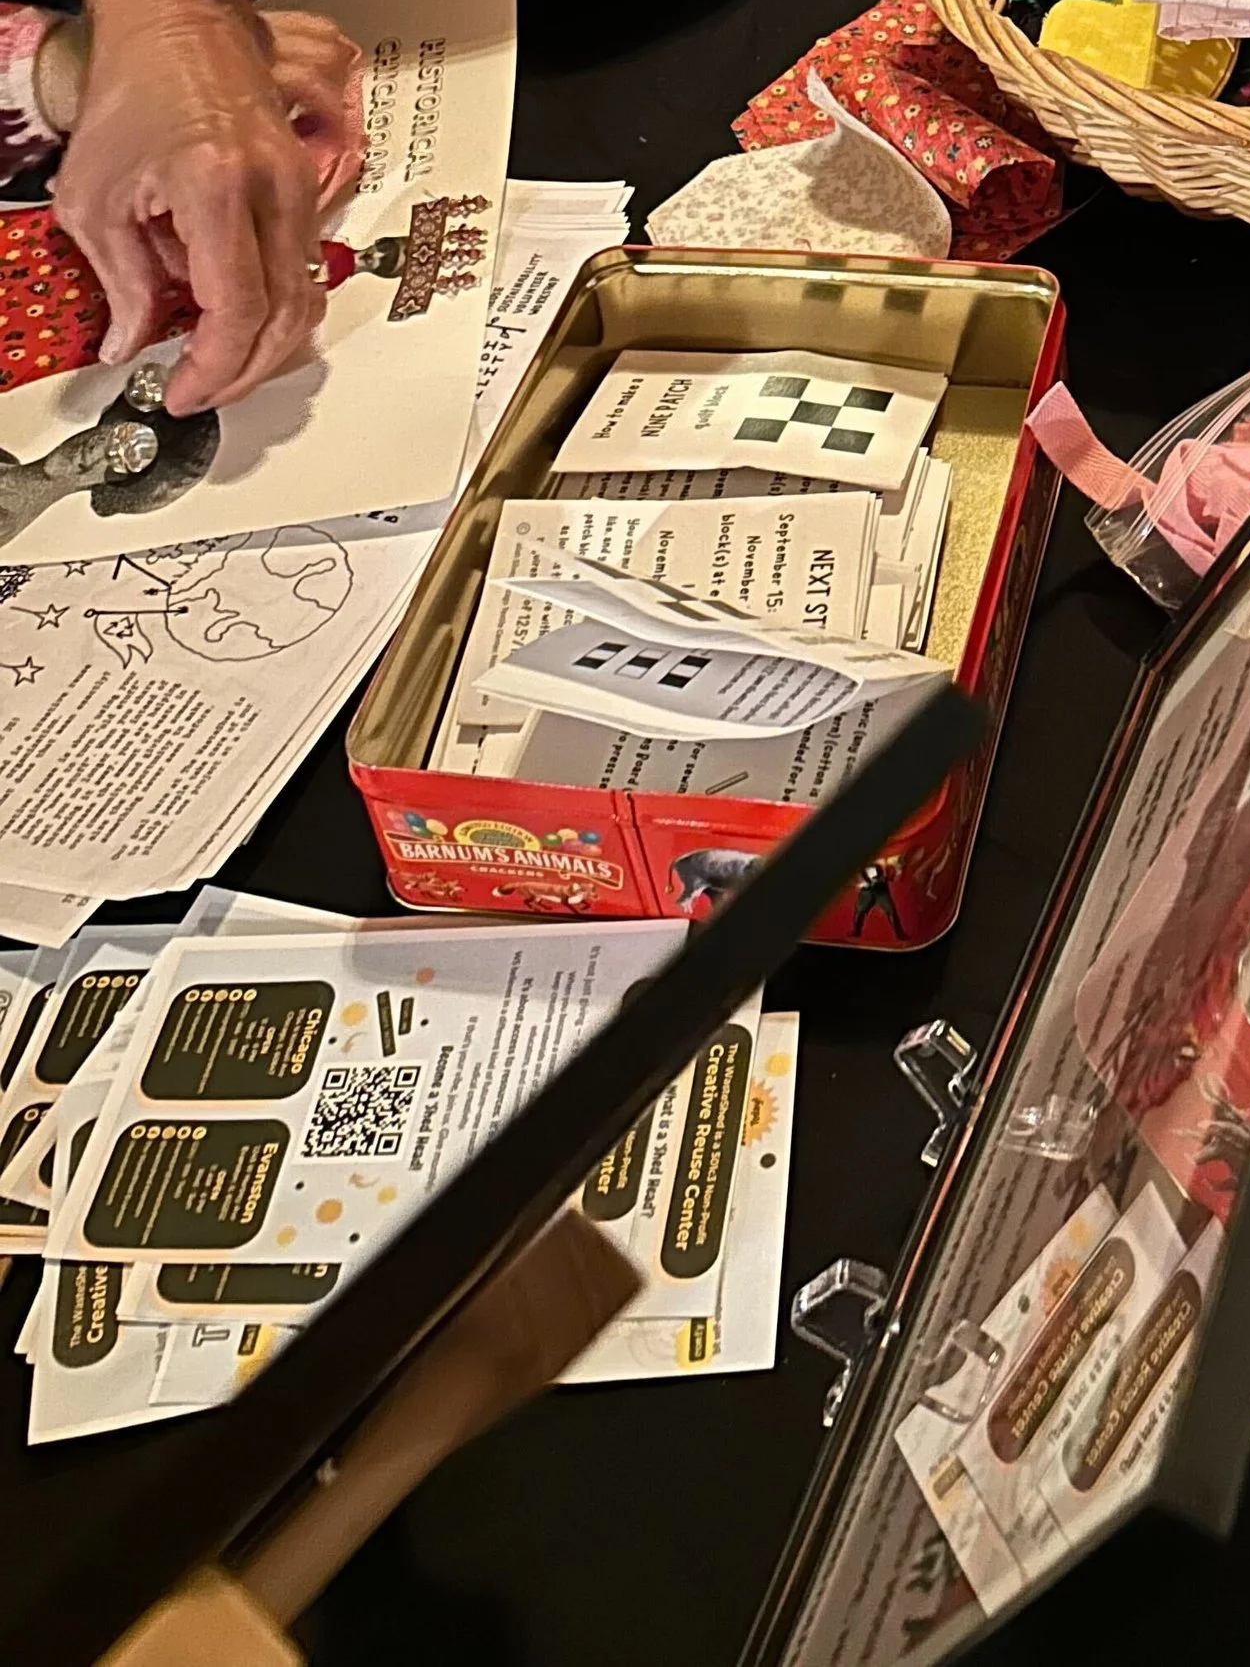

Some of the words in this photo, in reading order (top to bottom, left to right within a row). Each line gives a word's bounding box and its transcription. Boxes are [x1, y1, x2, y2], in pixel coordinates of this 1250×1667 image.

[357, 37, 401, 195] CHICAGOANS
[404, 37, 446, 183] HISTORICAL
[498, 253, 544, 313] SUSTAINABILITY
[512, 270, 548, 315] VOLUNTEER
[529, 277, 560, 316] WORKSHOP
[604, 407, 626, 418] to
[612, 384, 641, 405] make
[652, 378, 696, 410] PATCH
[702, 385, 731, 406] block
[591, 420, 620, 438] How
[636, 413, 674, 436] NINE
[687, 408, 721, 429] quilt
[580, 514, 594, 539] patch
[600, 537, 612, 553] and
[622, 538, 632, 555] can
[625, 518, 639, 536] You
[711, 514, 735, 567] block(s)
[768, 513, 795, 585] September
[711, 571, 726, 584] at
[737, 535, 762, 602] November
[806, 549, 836, 596] NEXT
[764, 590, 784, 612] 15:
[29, 691, 69, 733] creative
[68, 663, 92, 688] reuse
[34, 738, 55, 758] that
[74, 670, 113, 711] exactly?
[32, 766, 59, 794] reuse
[69, 722, 95, 748] about
[92, 693, 121, 720] using
[117, 670, 140, 691] your
[689, 741, 706, 760] for
[20, 817, 44, 840] into
[93, 727, 118, 750] When
[115, 708, 135, 725] you
[131, 679, 157, 704] share
[40, 803, 83, 848] throwing
[117, 739, 136, 756] you
[132, 720, 150, 737] are
[145, 681, 183, 718] helping
[56, 801, 98, 845] decrease
[94, 780, 114, 798] the
[112, 747, 141, 778] amount
[151, 703, 177, 730] waste
[67, 832, 85, 850] our
[83, 780, 129, 829] community
[124, 761, 143, 778] and
[140, 727, 172, 759] giving
[168, 689, 201, 724] someone
[107, 797, 126, 815] the
[124, 740, 175, 796] opportunity
[182, 700, 205, 722] make
[137, 819, 163, 842] help
[158, 783, 191, 816] people
[187, 760, 209, 780] take
[207, 736, 228, 757] care
[237, 703, 253, 718] our
[603, 742, 624, 774] press
[786, 764, 803, 785] for
[812, 738, 839, 786] (cotton
[10, 775, 65, 835] imagination
[74, 737, 97, 758] turn
[29, 822, 53, 846] what
[52, 801, 72, 819] you
[79, 751, 112, 783] longer
[107, 727, 131, 749] need
[98, 794, 144, 844] something
[140, 766, 166, 792] never
[164, 741, 185, 763] seen
[109, 843, 129, 861] Our
[127, 817, 151, 840] goal
[147, 791, 171, 815] here
[178, 758, 198, 775] The
[193, 709, 236, 755] WasteShed
[173, 798, 190, 815] one
[188, 759, 223, 796] project
[399, 842, 510, 865] BARNUM'S
[514, 850, 612, 879] ANIMALS
[469, 865, 544, 878] CRACKERS
[514, 993, 530, 1021] about
[520, 977, 533, 992] It's
[290, 1008, 322, 1074] Chicago
[503, 1055, 514, 1067] to
[506, 1023, 521, 1054] access
[725, 1042, 738, 1063] The
[430, 1045, 454, 1088] Become
[698, 1044, 725, 1119] Creative
[715, 1065, 734, 1128] WasteShed
[406, 1136, 430, 1171] Head!
[687, 1124, 711, 1180] Reuse
[713, 1130, 724, 1140] is
[240, 1142, 279, 1224] Evanston
[595, 1155, 617, 1194] nter
[674, 1184, 700, 1251] Center
[695, 1184, 714, 1244] Non-Profit
[86, 1265, 109, 1344] Creative
[70, 1323, 83, 1349] The
